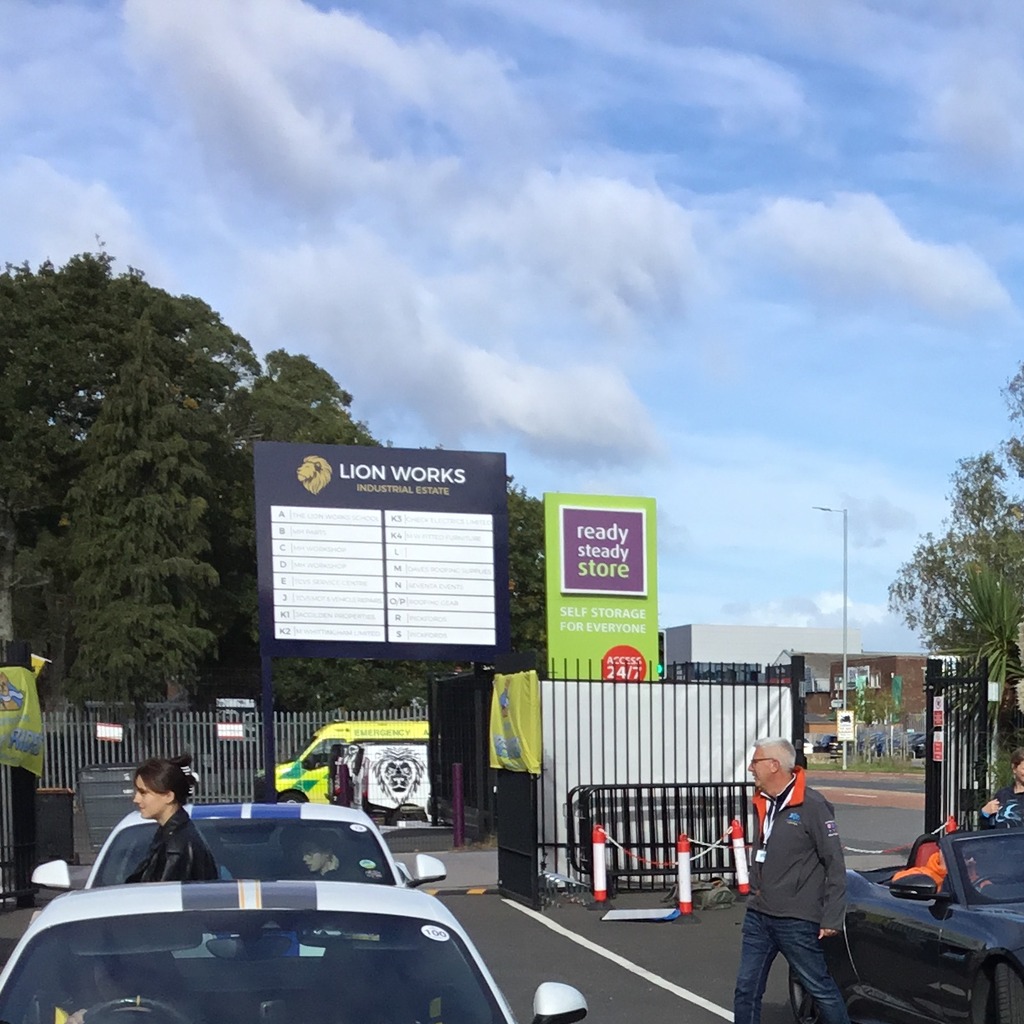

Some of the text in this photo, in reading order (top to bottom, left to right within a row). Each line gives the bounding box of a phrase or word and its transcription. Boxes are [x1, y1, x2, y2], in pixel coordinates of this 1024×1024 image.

[340, 463, 466, 484] LION WORKS
[357, 484, 450, 495] INDUSTRIAL ESTATE
[278, 510, 286, 518] A
[391, 515, 402, 523] K3
[279, 527, 286, 535] B
[577, 523, 629, 545] ready
[390, 532, 403, 540] K4
[394, 548, 399, 556] L
[578, 544, 629, 562] steady
[578, 559, 630, 578] store
[281, 577, 287, 585] E
[389, 598, 406, 606] O/P
[560, 607, 646, 619] SELF STORAGE
[560, 621, 647, 634] FOR EVERYONE
[606, 656, 643, 665] ACCESS
[606, 665, 643, 680] 24/7
[354, 729, 411, 737] EMERGENCY
[425, 929, 447, 938] 100
